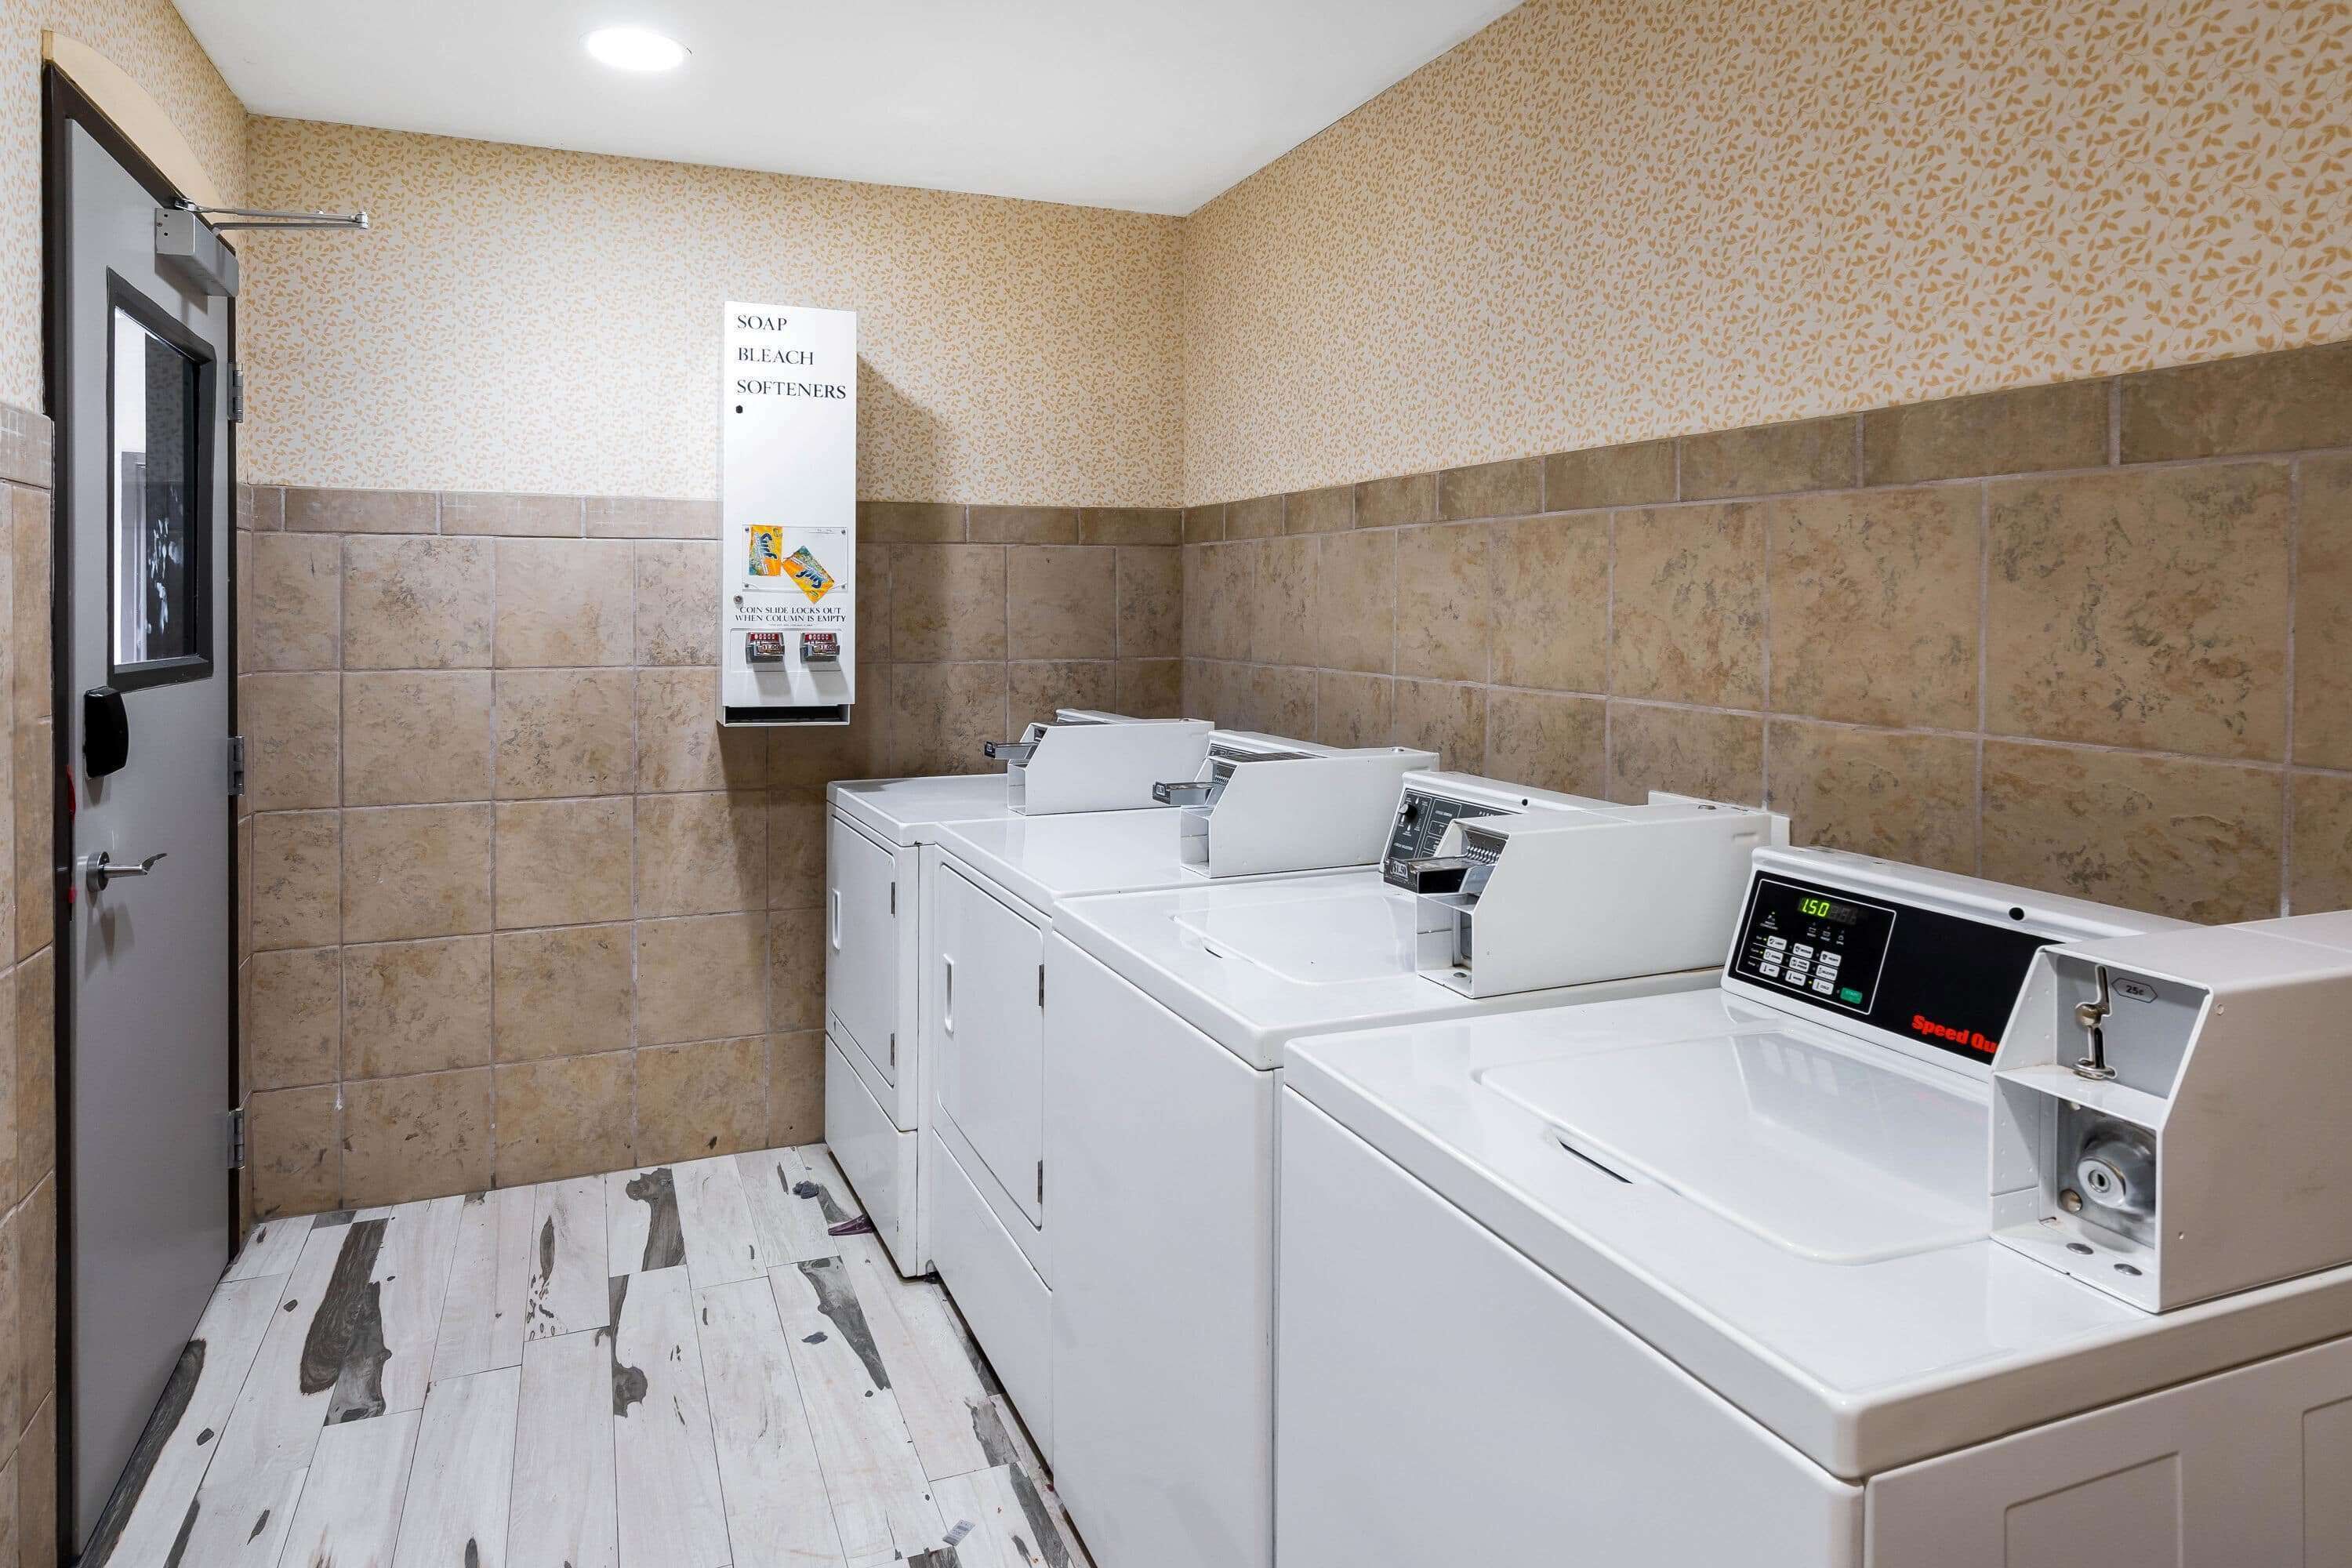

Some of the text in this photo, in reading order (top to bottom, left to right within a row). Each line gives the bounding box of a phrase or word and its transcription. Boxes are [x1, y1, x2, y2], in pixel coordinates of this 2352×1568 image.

[737, 314, 787, 331] SOAP
[739, 347, 814, 365] BLEACH
[737, 379, 847, 399] SOFTENERS
[1912, 1014, 1969, 1044] Speed
